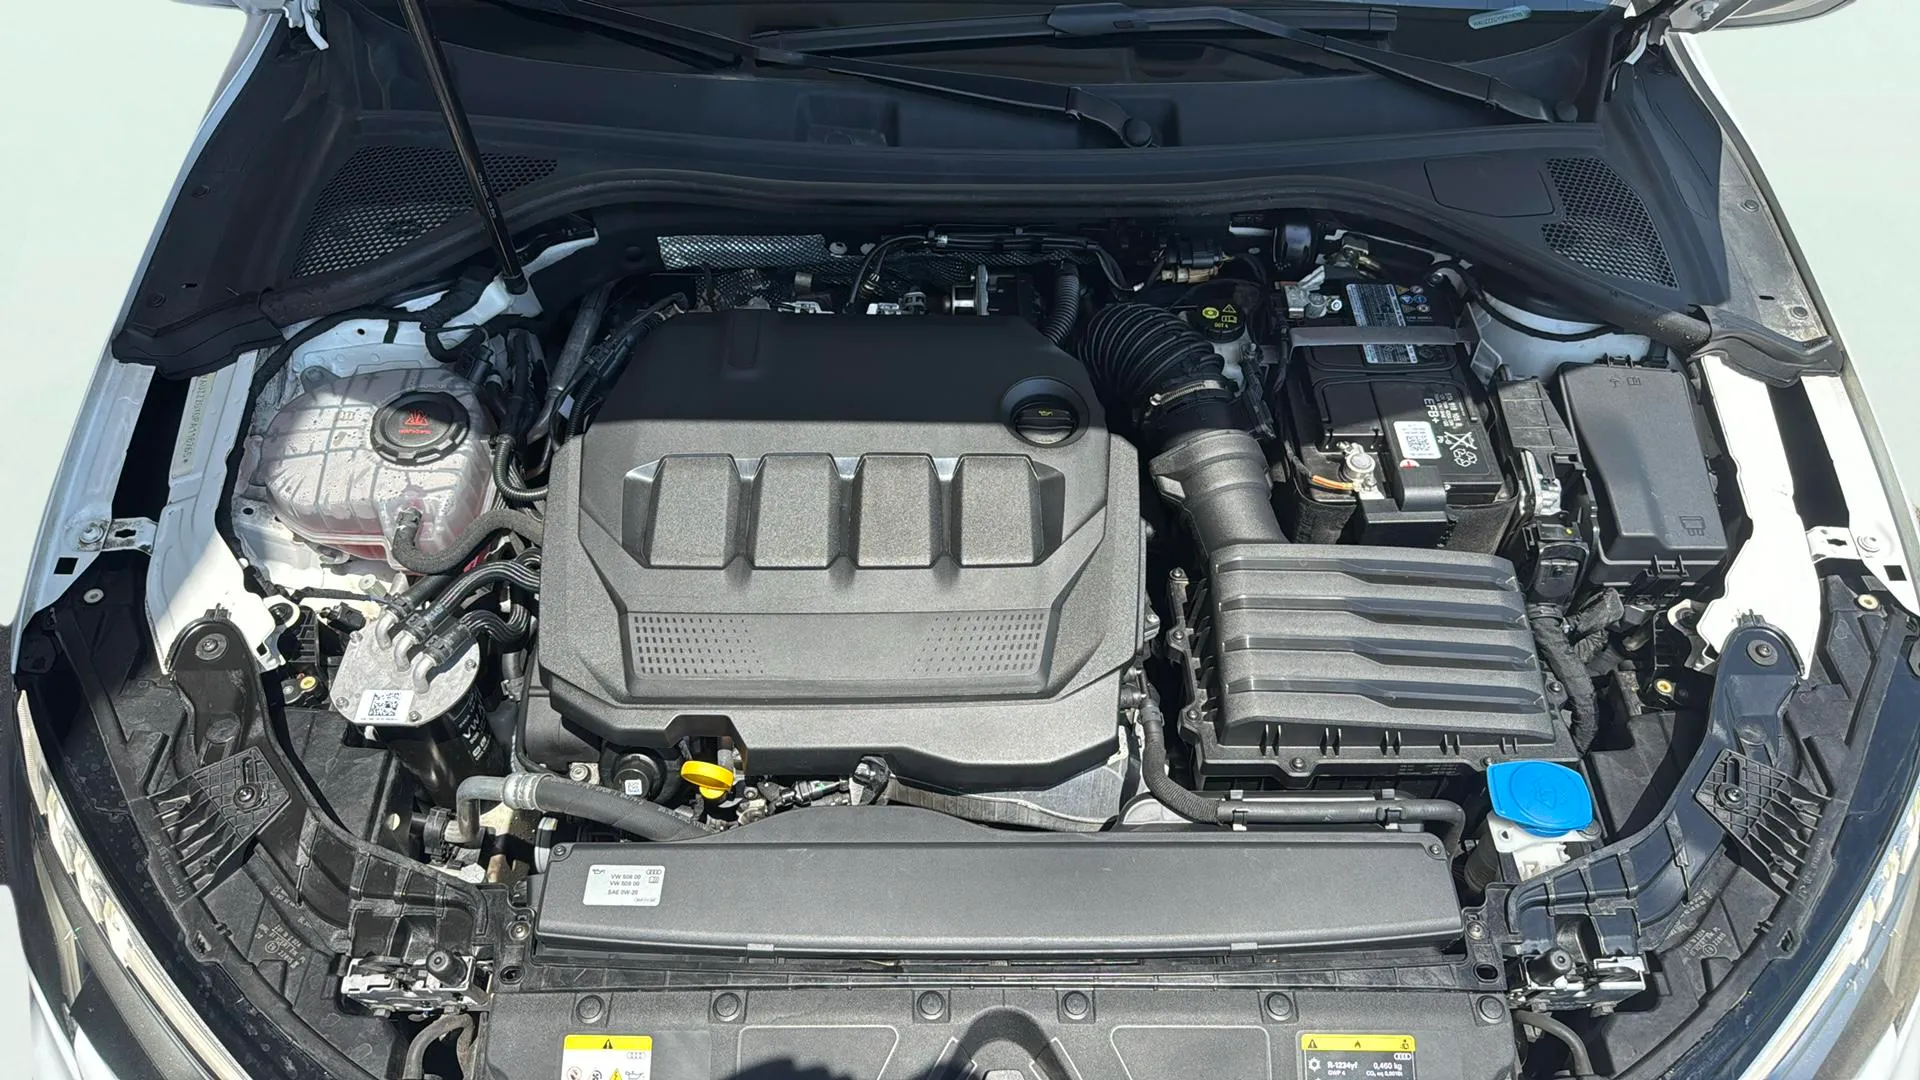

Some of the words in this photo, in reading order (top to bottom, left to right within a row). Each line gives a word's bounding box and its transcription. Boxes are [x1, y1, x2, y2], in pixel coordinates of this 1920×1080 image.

[1423, 398, 1440, 424] EFB+
[1327, 1061, 1358, 1071] R-1234yf
[1393, 1062, 1403, 1071] kg
